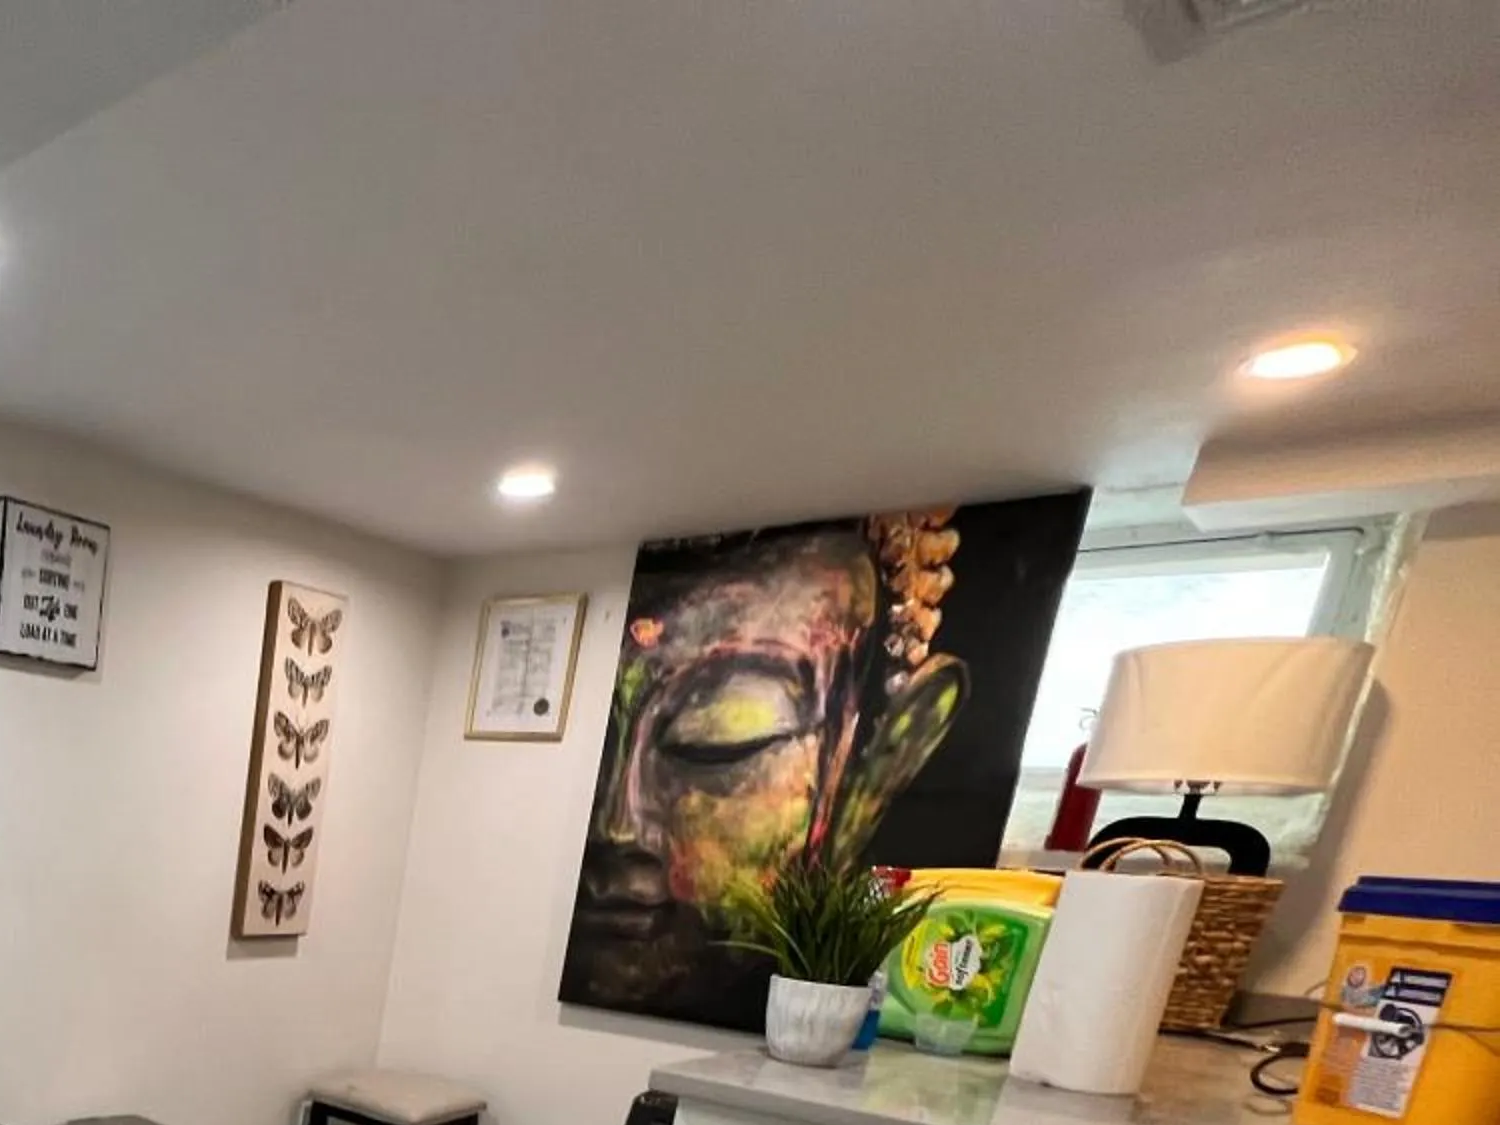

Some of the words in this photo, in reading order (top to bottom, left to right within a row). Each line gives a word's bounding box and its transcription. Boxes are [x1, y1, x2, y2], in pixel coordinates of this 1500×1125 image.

[16, 511, 64, 549] Laundry
[71, 525, 98, 555] Room
[927, 942, 950, 986] Gain
